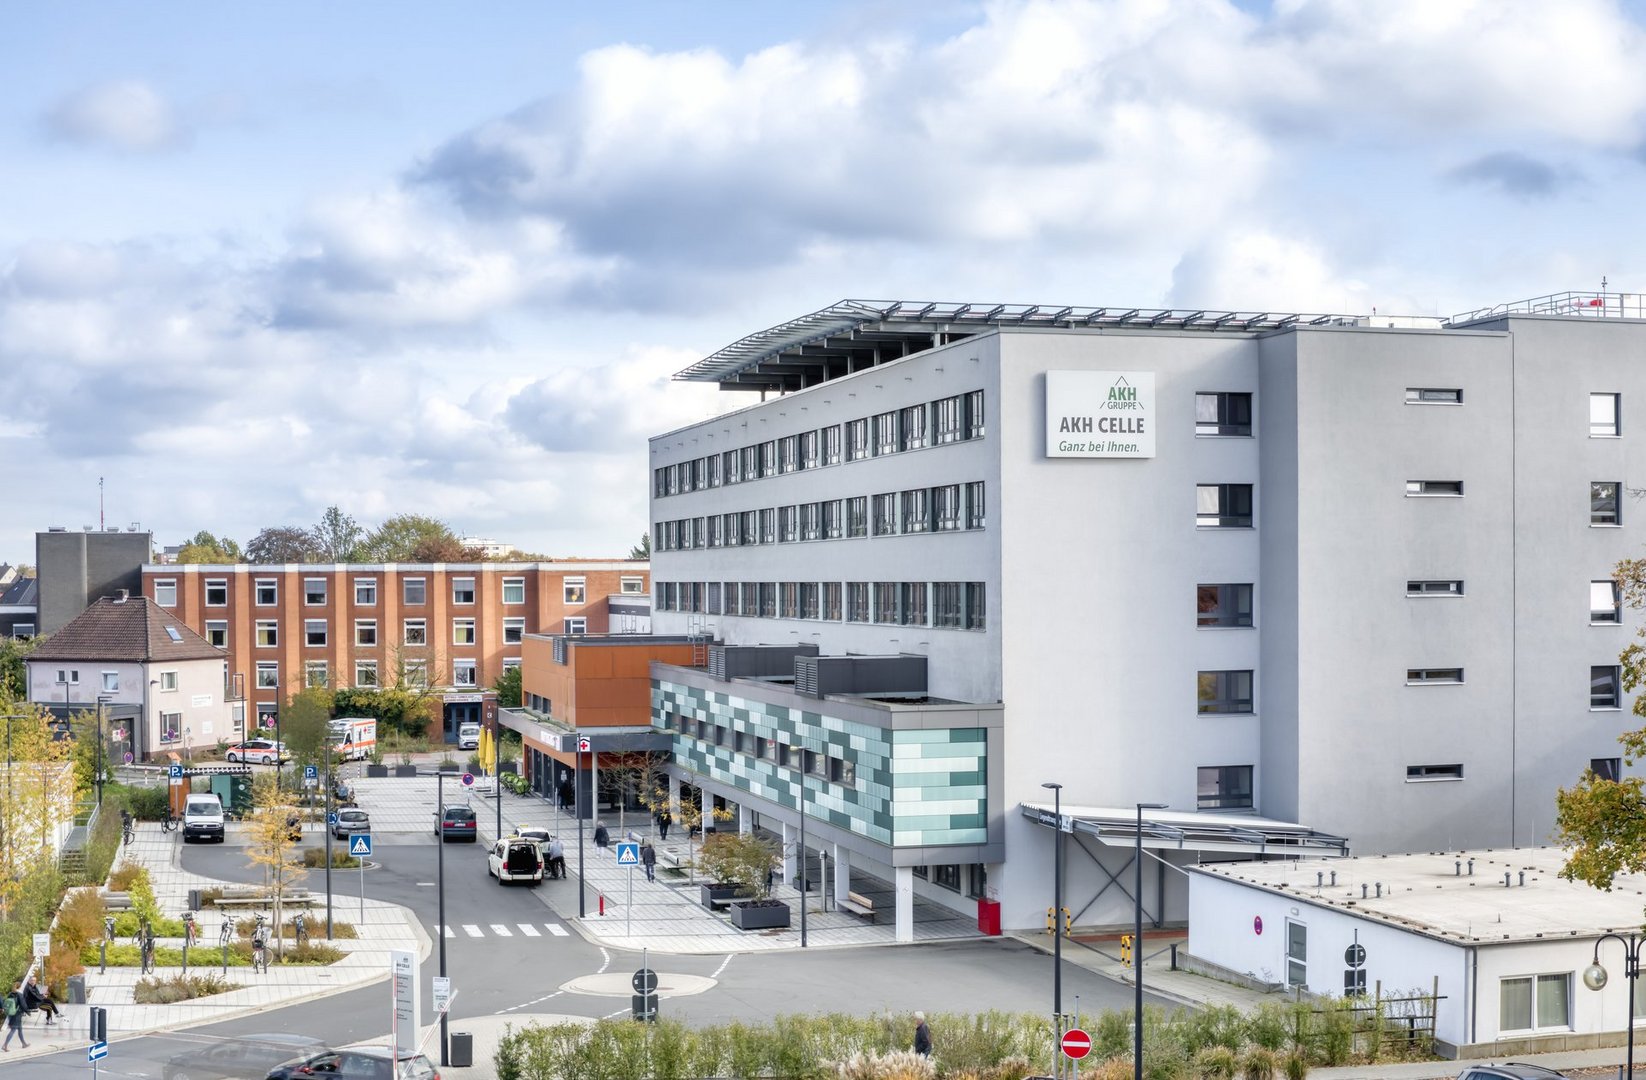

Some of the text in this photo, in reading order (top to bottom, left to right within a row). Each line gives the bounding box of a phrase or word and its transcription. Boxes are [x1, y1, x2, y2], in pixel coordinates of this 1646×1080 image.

[1107, 386, 1137, 401] AKH
[1107, 401, 1137, 410] GRUPPE
[1059, 416, 1145, 434] AKH CELLE
[1058, 440, 1140, 452] Ganz bei Ihnen.
[171, 766, 179, 777] P
[306, 767, 314, 777] P
